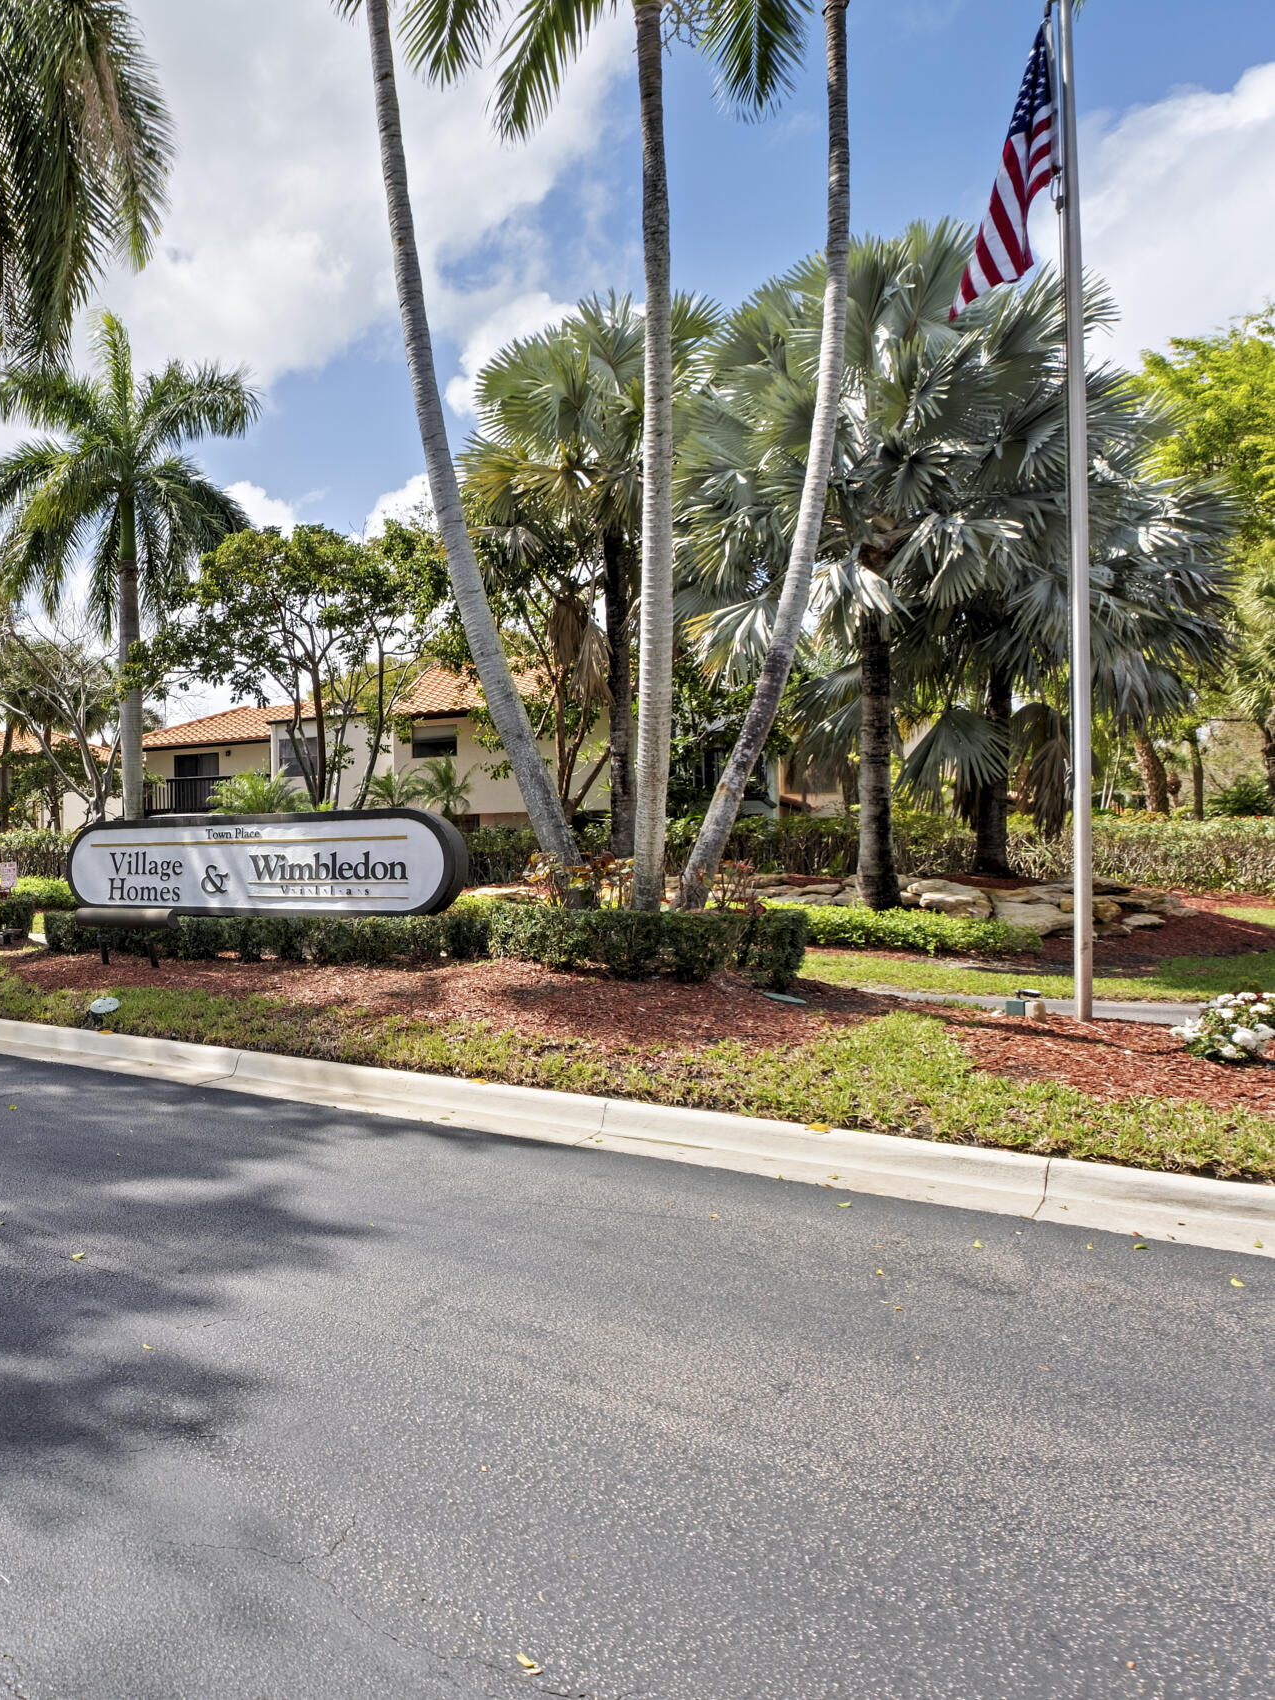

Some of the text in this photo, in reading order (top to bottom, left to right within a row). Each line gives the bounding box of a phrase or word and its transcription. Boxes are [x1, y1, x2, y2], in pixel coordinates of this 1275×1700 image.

[205, 827, 261, 840] Town Place
[109, 851, 183, 881] Village
[200, 864, 229, 894] &
[248, 851, 409, 881] Wimbledon
[108, 877, 181, 902] Homes
